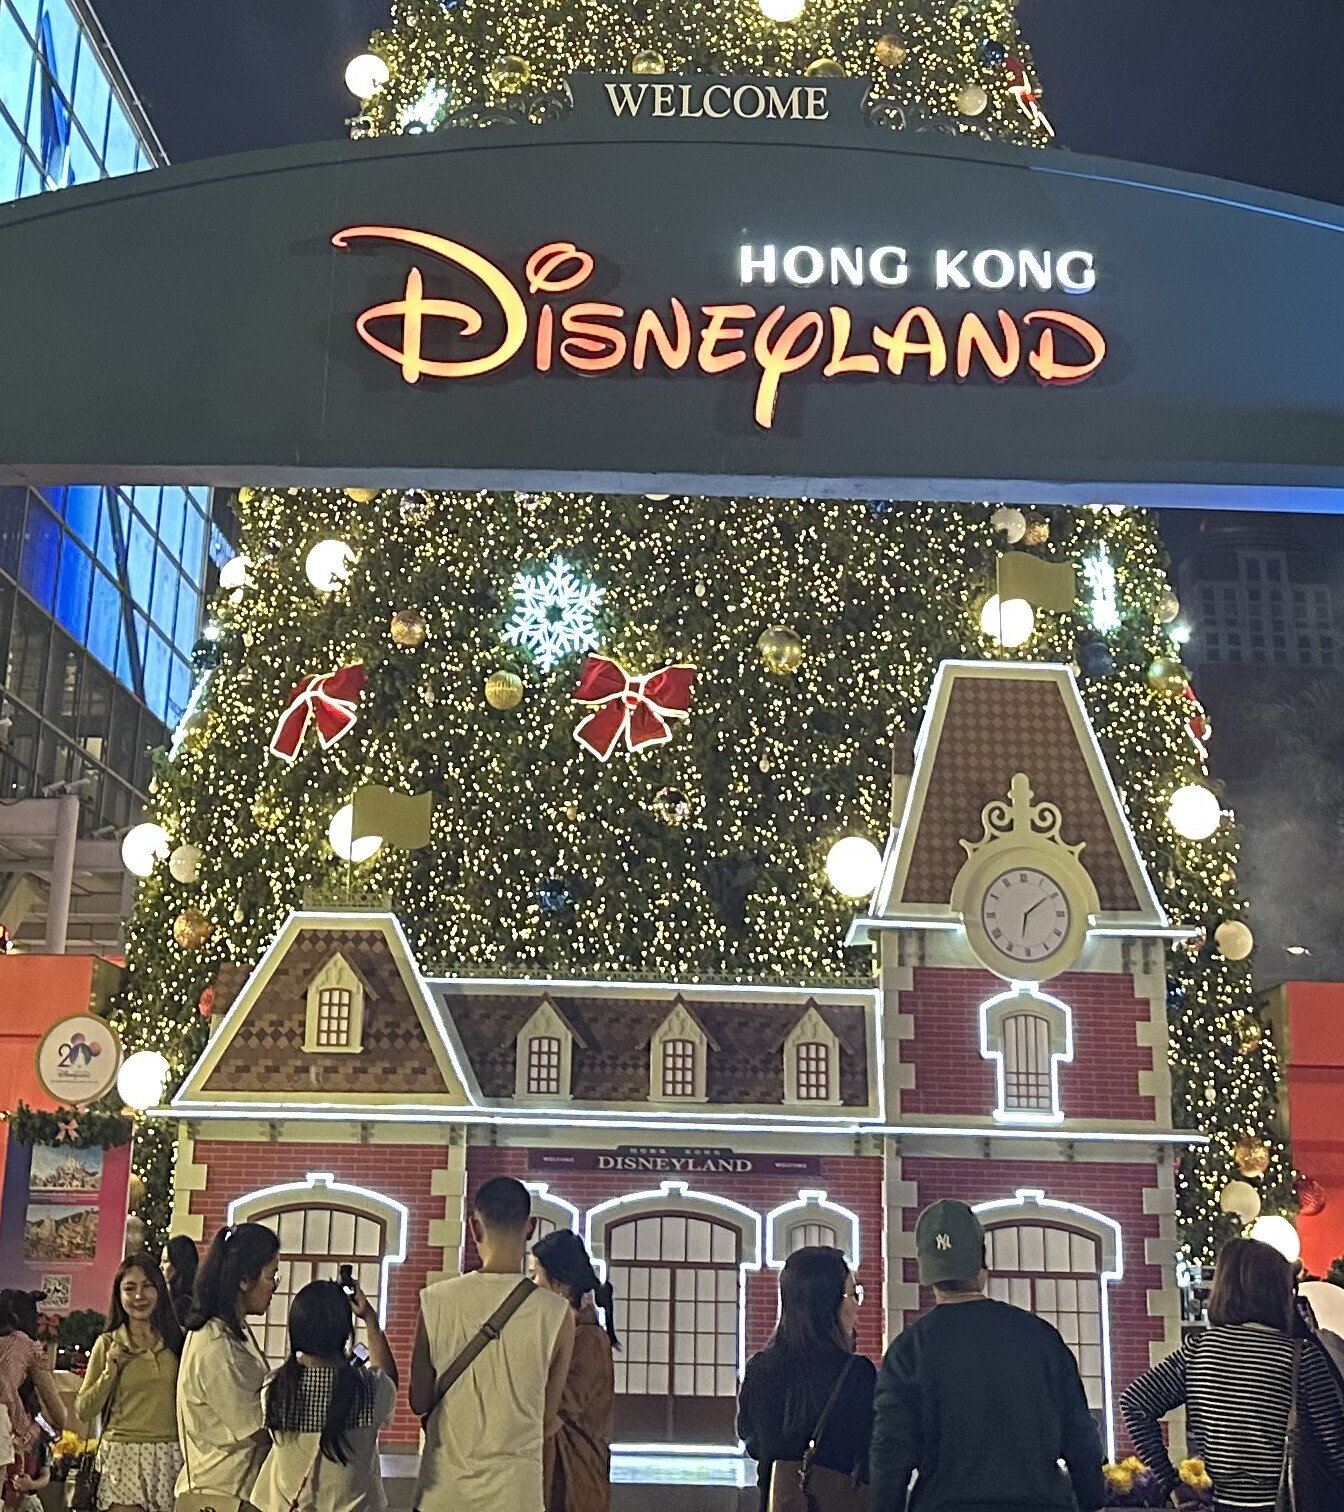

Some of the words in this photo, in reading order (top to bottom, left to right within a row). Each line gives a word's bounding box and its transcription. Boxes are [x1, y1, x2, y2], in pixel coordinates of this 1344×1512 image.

[605, 83, 830, 120] WELCOME
[740, 244, 908, 286] HONG
[935, 249, 1097, 293] KONG
[598, 1155, 753, 1173] DISNEYLAND
[935, 1233, 952, 1251] NY
